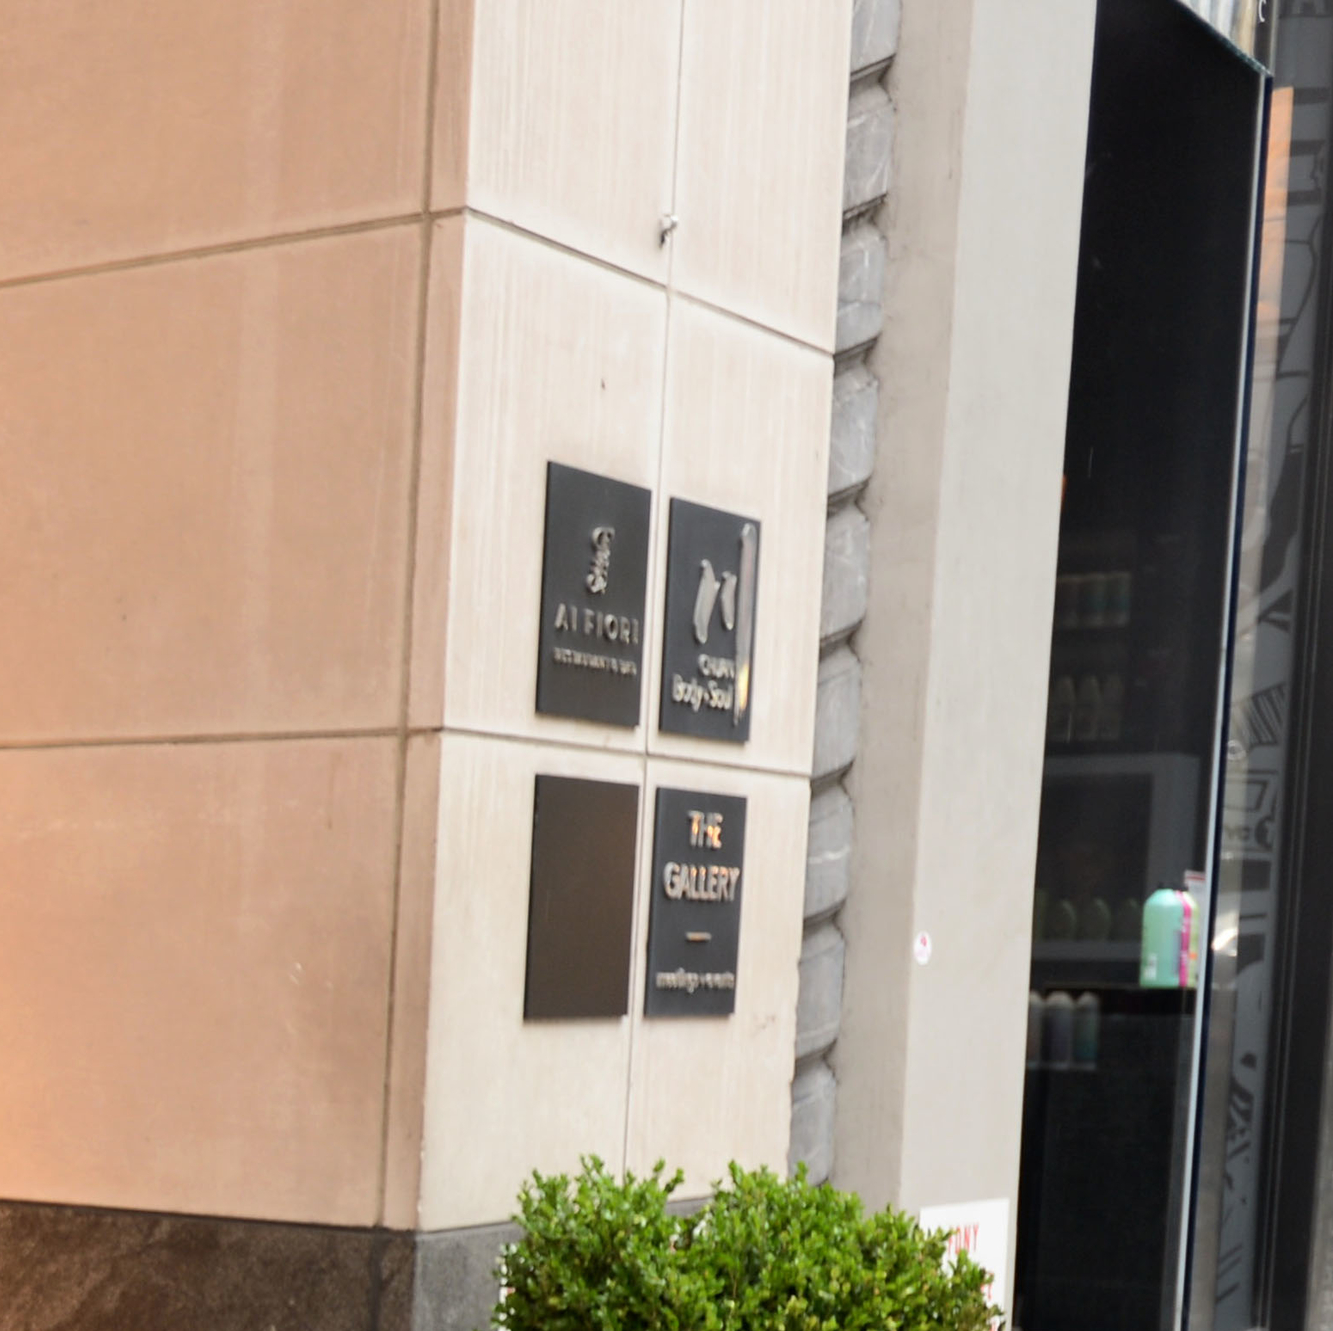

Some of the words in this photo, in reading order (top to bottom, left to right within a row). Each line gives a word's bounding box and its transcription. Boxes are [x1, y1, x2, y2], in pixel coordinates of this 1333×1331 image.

[584, 607, 640, 645] FIORI
[688, 810, 724, 848] THE
[663, 861, 741, 902] GALLERY
